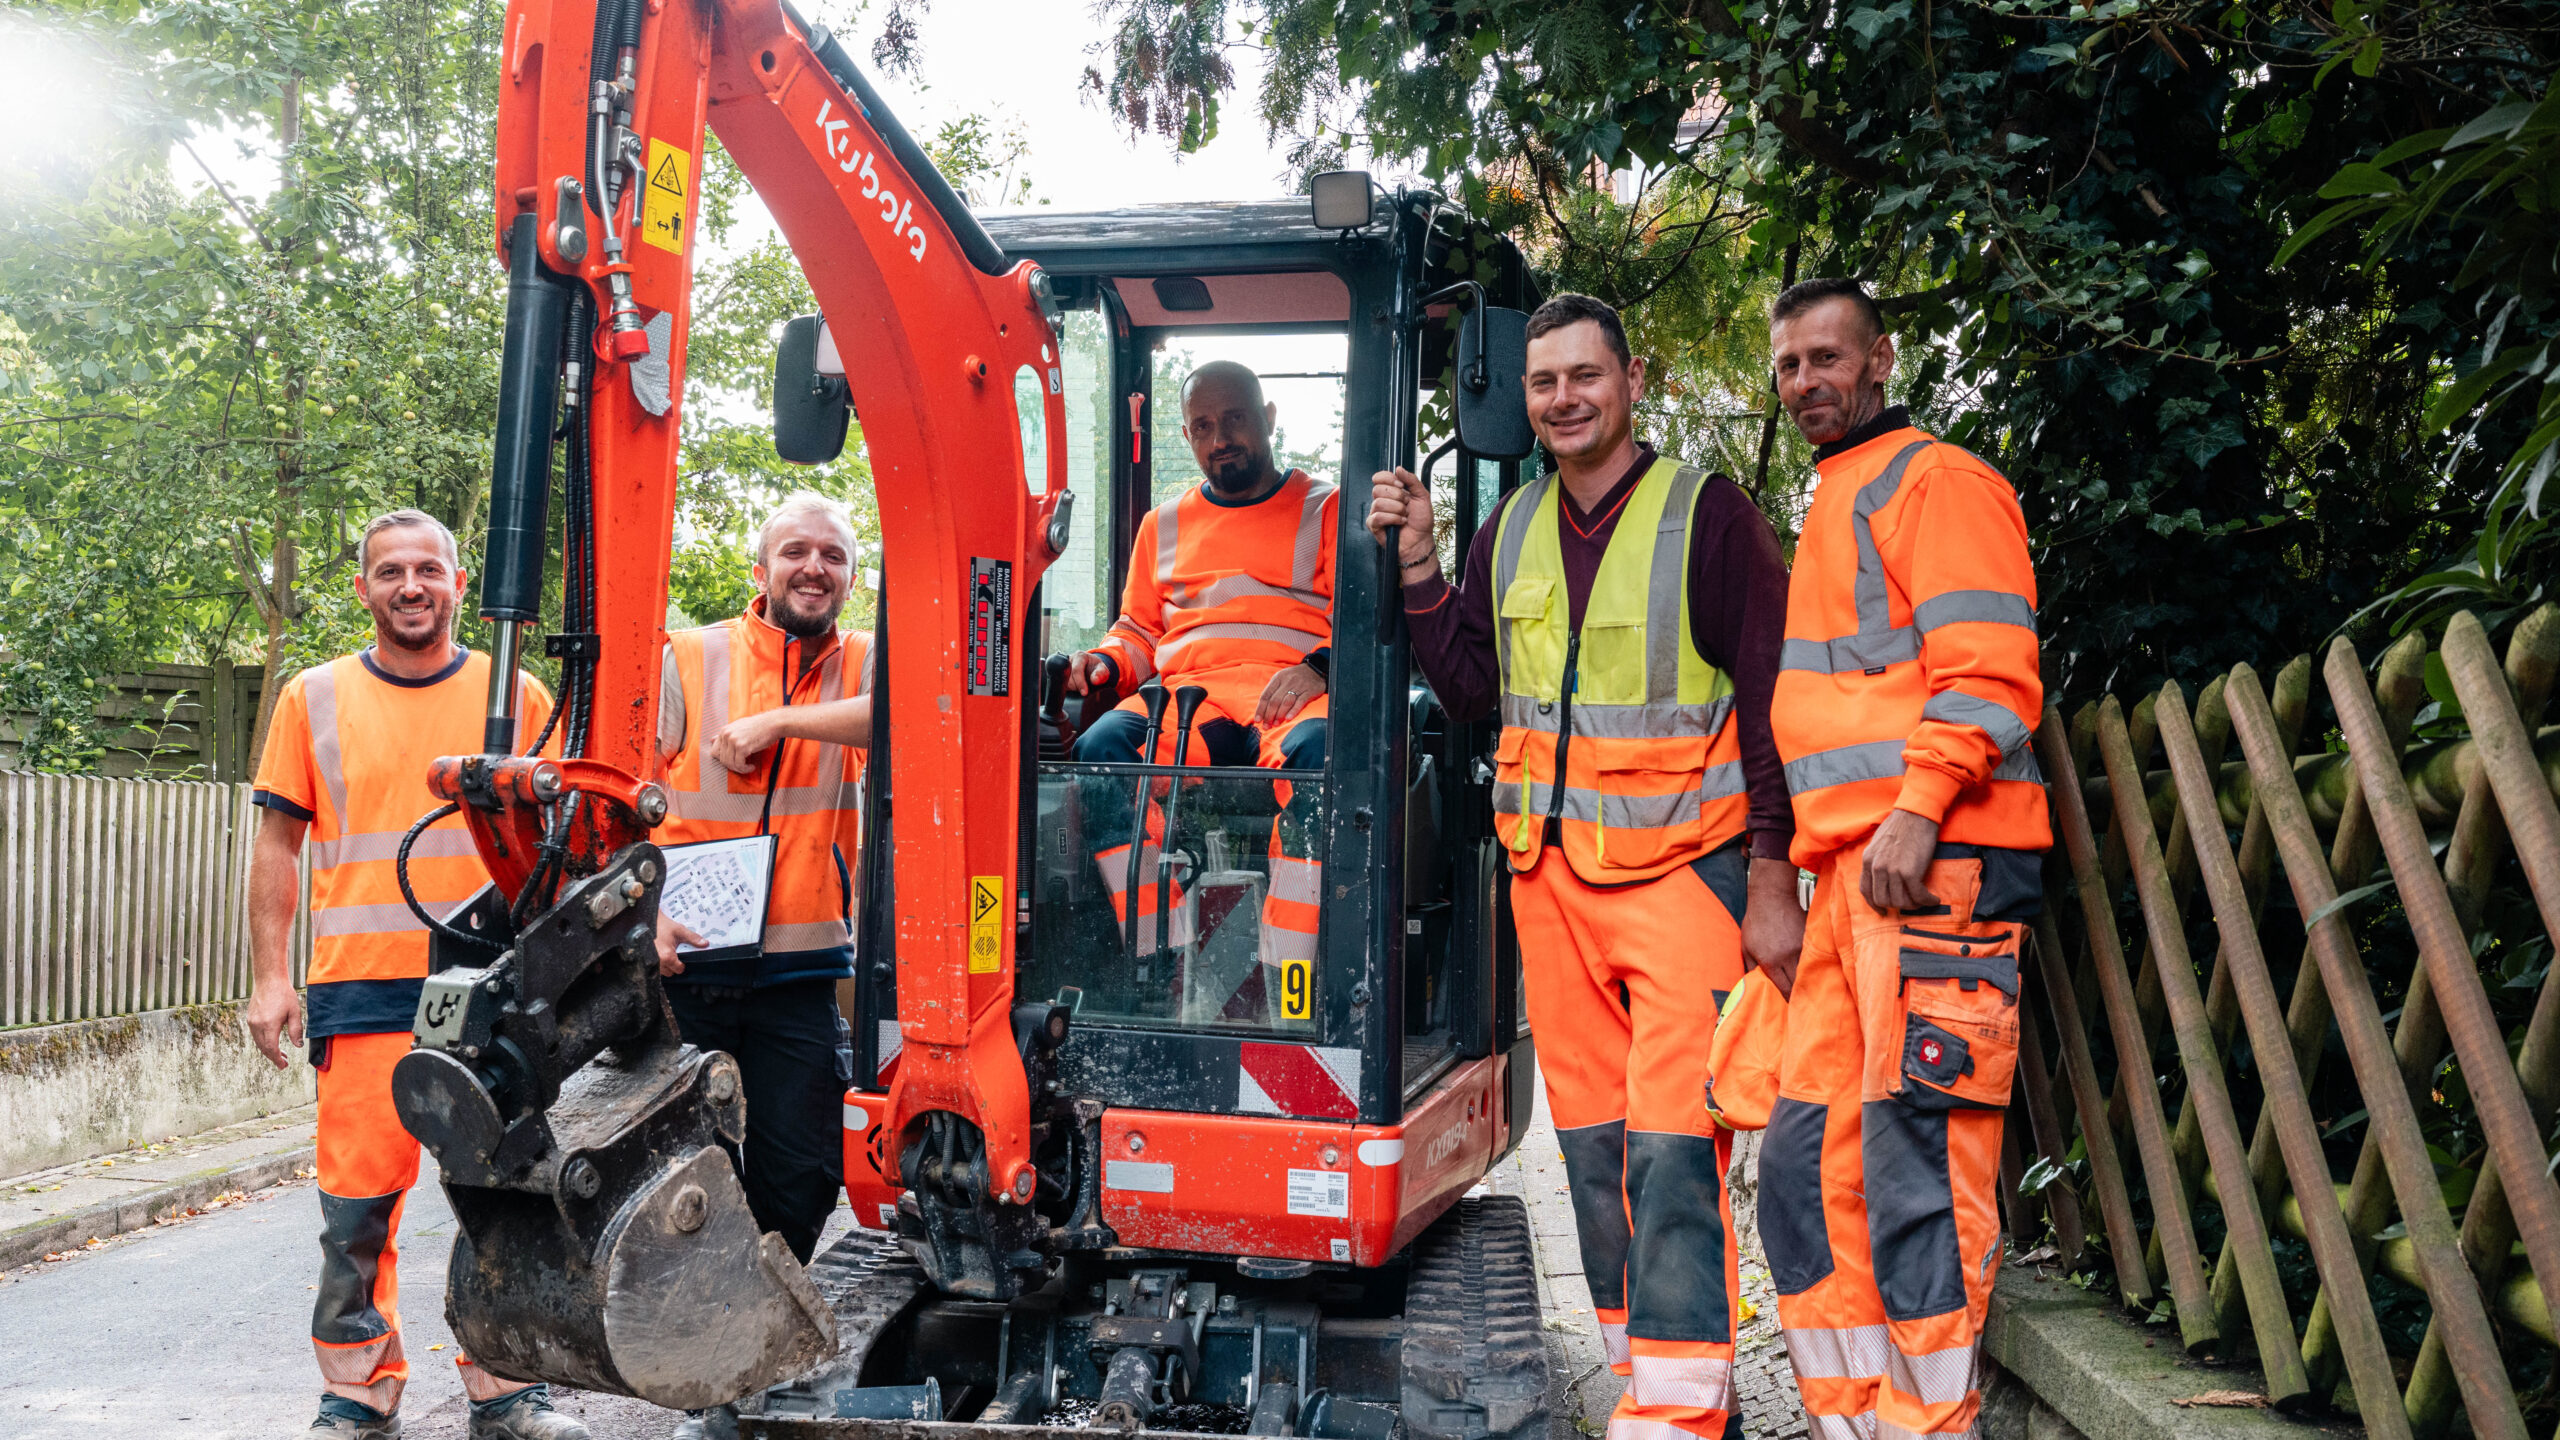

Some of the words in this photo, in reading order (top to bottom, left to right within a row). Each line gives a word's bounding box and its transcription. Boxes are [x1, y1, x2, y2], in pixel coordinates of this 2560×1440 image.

[816, 98, 926, 263] Kubota
[976, 573, 994, 686] KUHN
[994, 620, 1002, 693] WERKSTATTSERVICE
[1286, 963, 1305, 1016] 9
